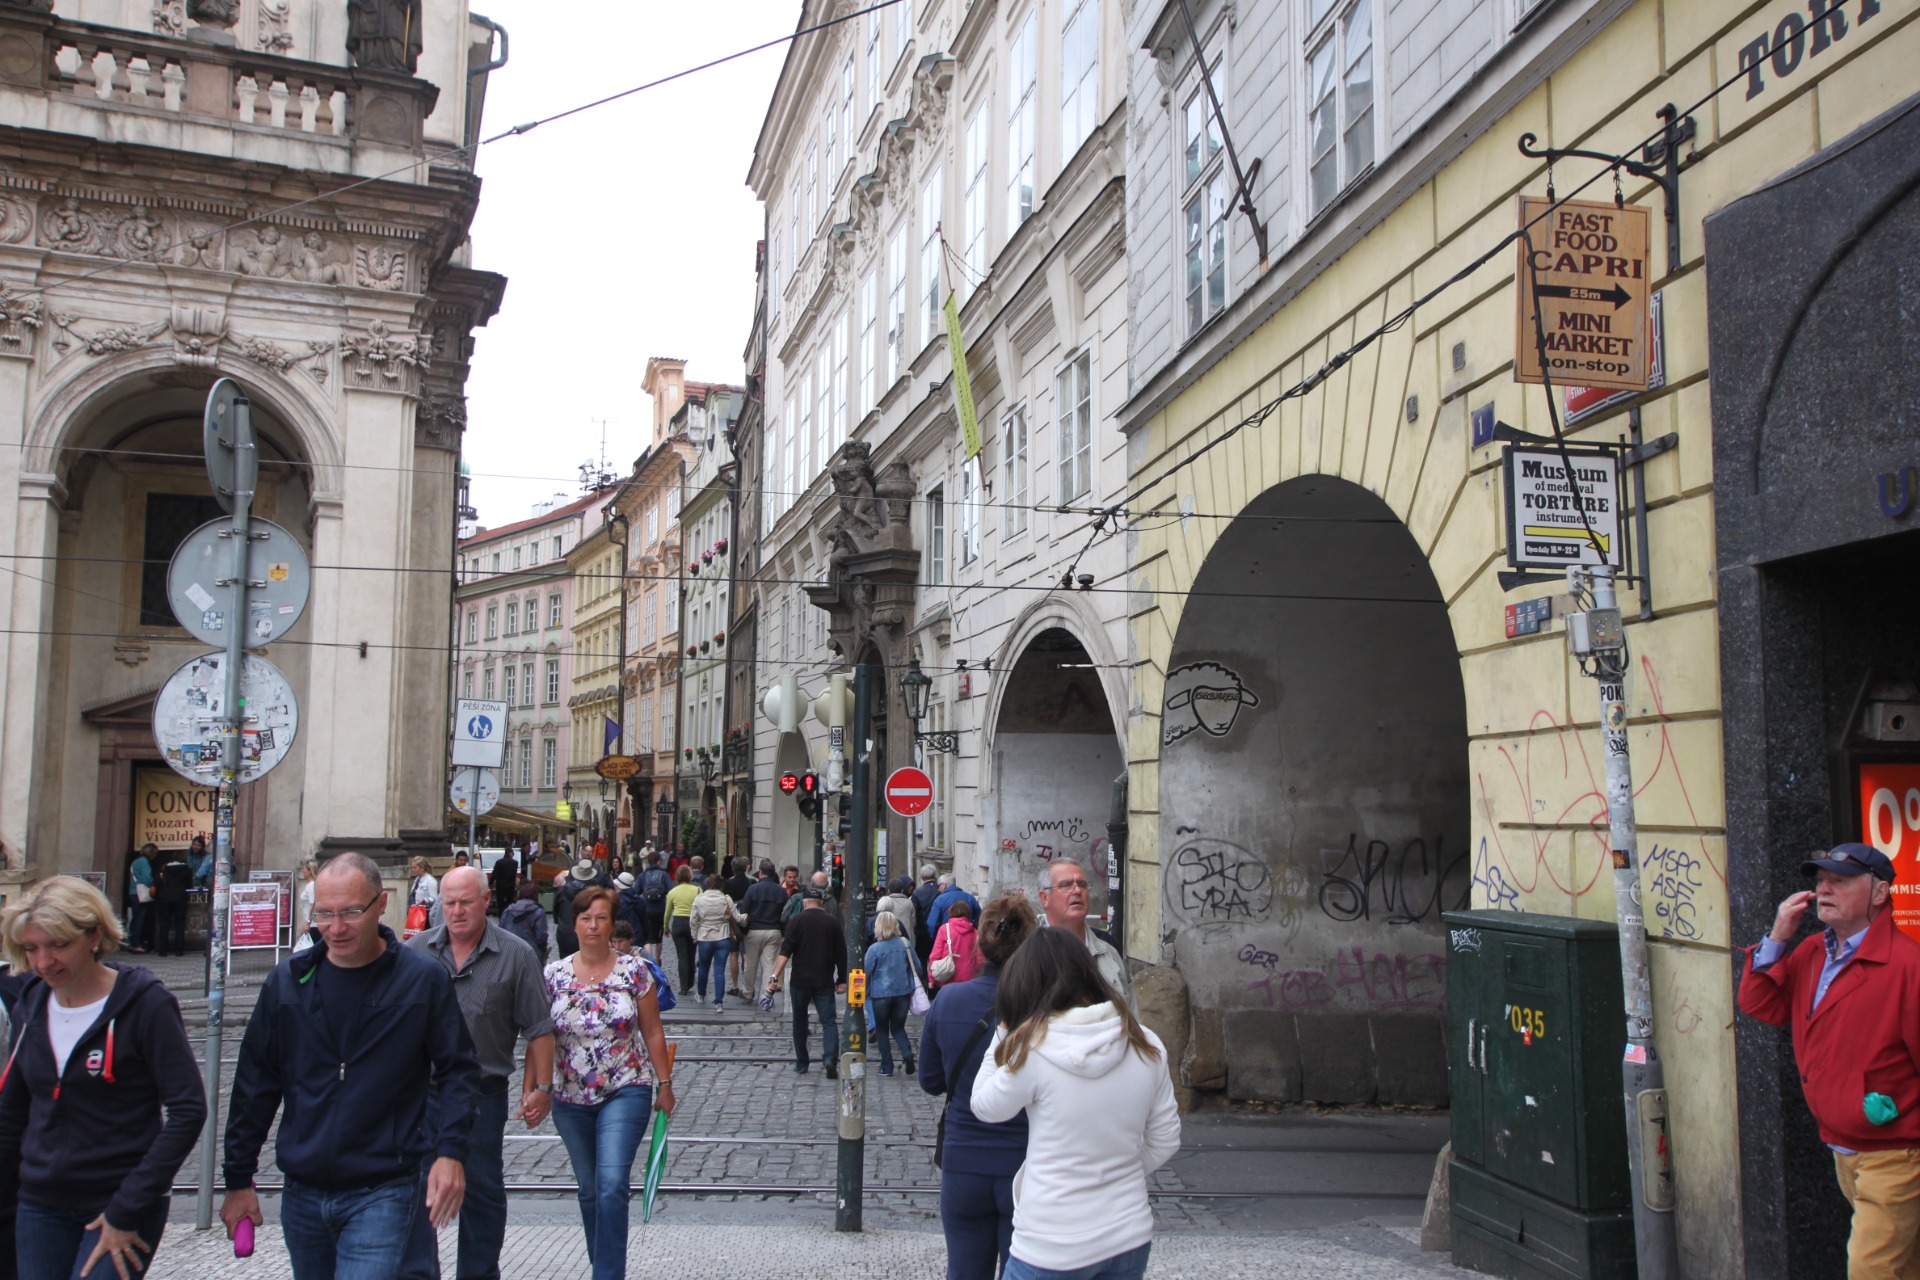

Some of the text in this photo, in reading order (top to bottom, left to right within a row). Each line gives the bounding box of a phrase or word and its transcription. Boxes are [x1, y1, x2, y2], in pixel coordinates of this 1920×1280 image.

[1559, 212, 1613, 233] FAST
[1554, 230, 1618, 252] FOOD
[1527, 251, 1643, 279] CAPRI
[1569, 289, 1601, 300] 25m
[1558, 312, 1611, 333] MINI
[1535, 332, 1633, 356] MARKET
[1538, 357, 1630, 376] non-stop
[1521, 460, 1608, 482] Museum
[1535, 481, 1594, 494] of medival
[1523, 493, 1609, 512] TORTURE
[1600, 685, 1624, 702] POK
[481, 703, 501, 712] ZÓNA
[781, 777, 796, 789] 52
[145, 818, 194, 828] Mozart
[145, 831, 193, 842] Vivaldi
[1511, 1005, 1545, 1038] 035
